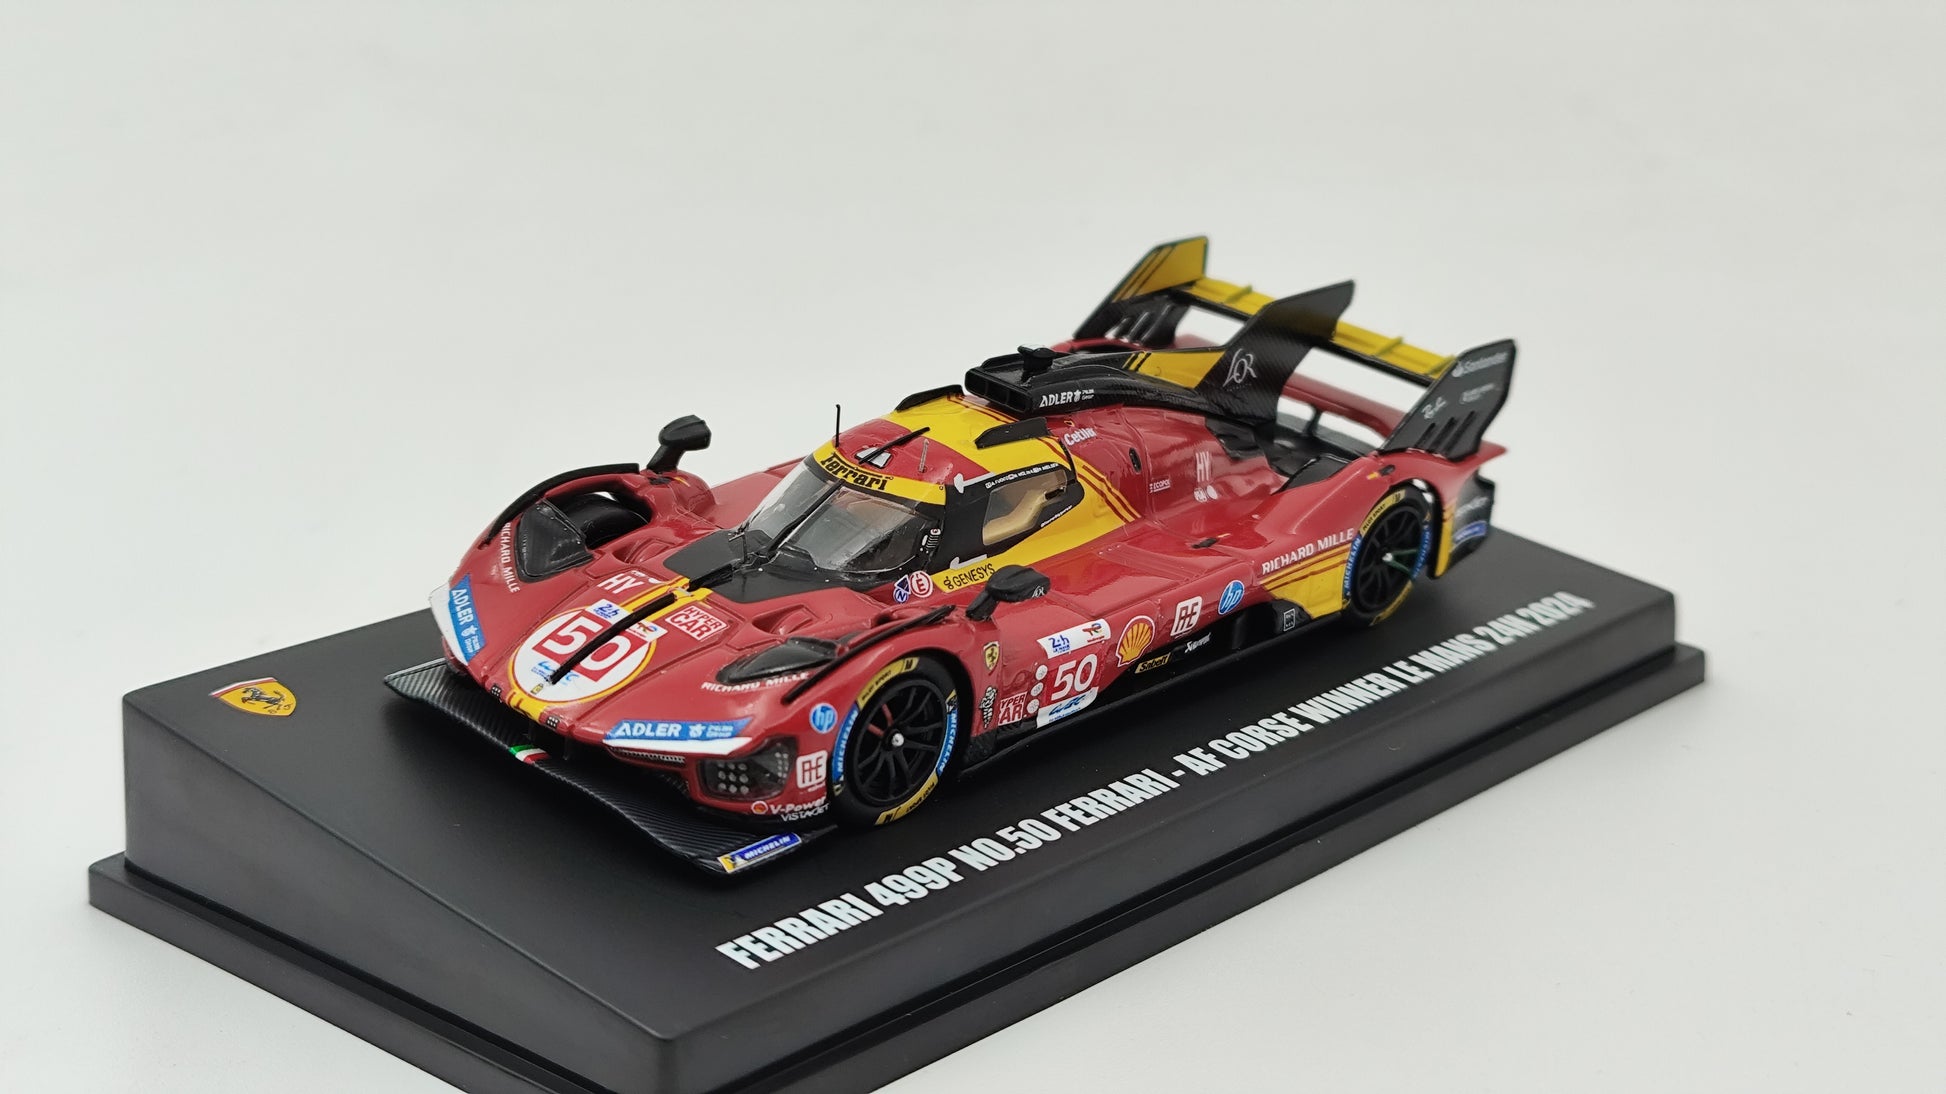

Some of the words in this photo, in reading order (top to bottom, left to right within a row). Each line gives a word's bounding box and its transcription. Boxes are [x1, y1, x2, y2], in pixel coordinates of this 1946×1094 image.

[1039, 391, 1074, 408] ADLER
[820, 452, 889, 491] Ferrari
[1261, 542, 1315, 576] RICHARD
[1316, 527, 1355, 552] MILLE
[1343, 538, 1361, 590] MICHELIN
[502, 566, 521, 594] MILLE
[597, 573, 644, 594] HY
[953, 563, 997, 588] GENESYS
[451, 588, 475, 626] ADLER
[1221, 581, 1242, 611] hp
[670, 613, 712, 638] CAR
[683, 606, 723, 630] HYPER
[540, 615, 632, 672] 50
[701, 681, 761, 693] RICHARD
[765, 671, 811, 688] MILLE
[1051, 653, 1098, 701] 50
[613, 722, 683, 738] ADLER
[814, 708, 834, 733] hp
[836, 710, 859, 773] MICHELIN
[938, 713, 958, 774] MICHELIN
[715, 893, 884, 971] FERRARI
[863, 856, 966, 907] 499P
[948, 817, 1063, 873] NO.50
[1041, 768, 1182, 833] FERRARI
[1173, 746, 1228, 777] AF
[1208, 711, 1316, 761] CORSE
[1287, 670, 1409, 726] WINNER
[1381, 659, 1436, 686] LE
[1409, 633, 1499, 675] MANS
[1472, 612, 1543, 647] 24H
[1515, 590, 1597, 630] 2024
[769, 796, 827, 815] V-Power
[744, 835, 791, 860] MICHELIN
